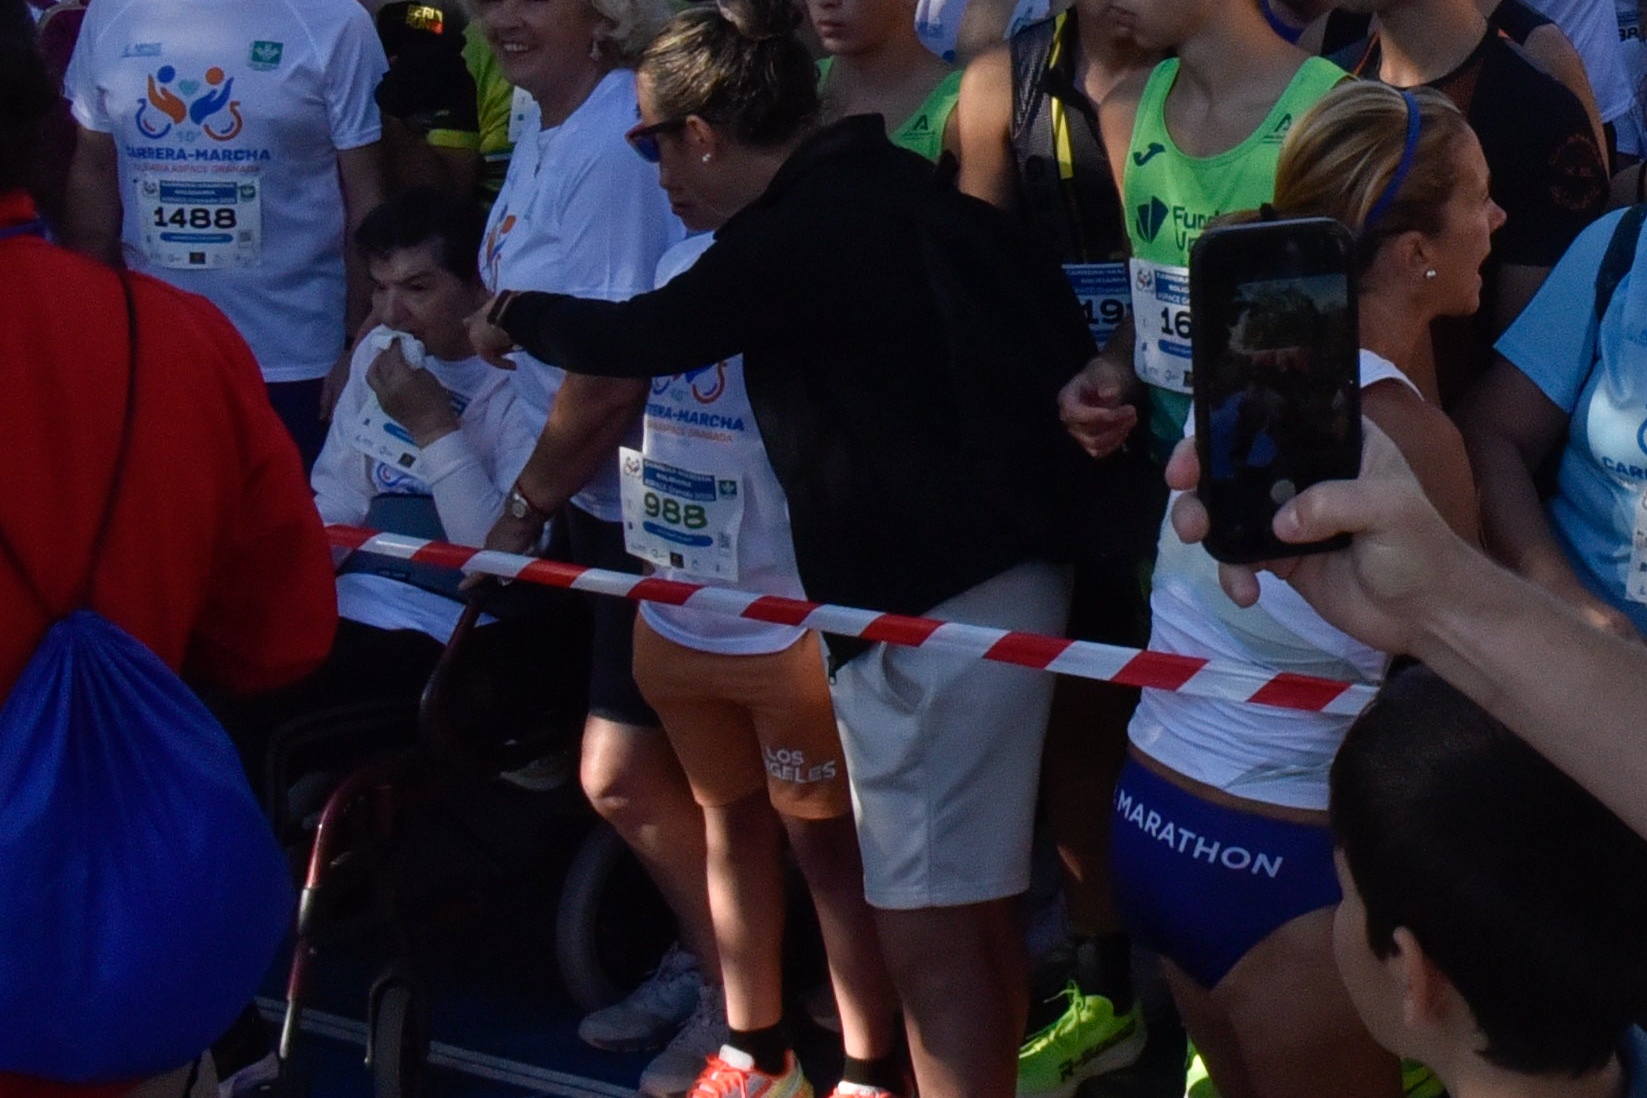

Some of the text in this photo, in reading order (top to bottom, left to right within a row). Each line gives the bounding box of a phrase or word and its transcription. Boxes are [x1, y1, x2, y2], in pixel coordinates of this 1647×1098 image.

[154, 206, 237, 229] 1488
[1161, 307, 1192, 339] 16
[644, 492, 709, 530] 988
[766, 746, 805, 767] LOS
[765, 760, 837, 784] GELES
[1117, 789, 1284, 879] MARATHON
